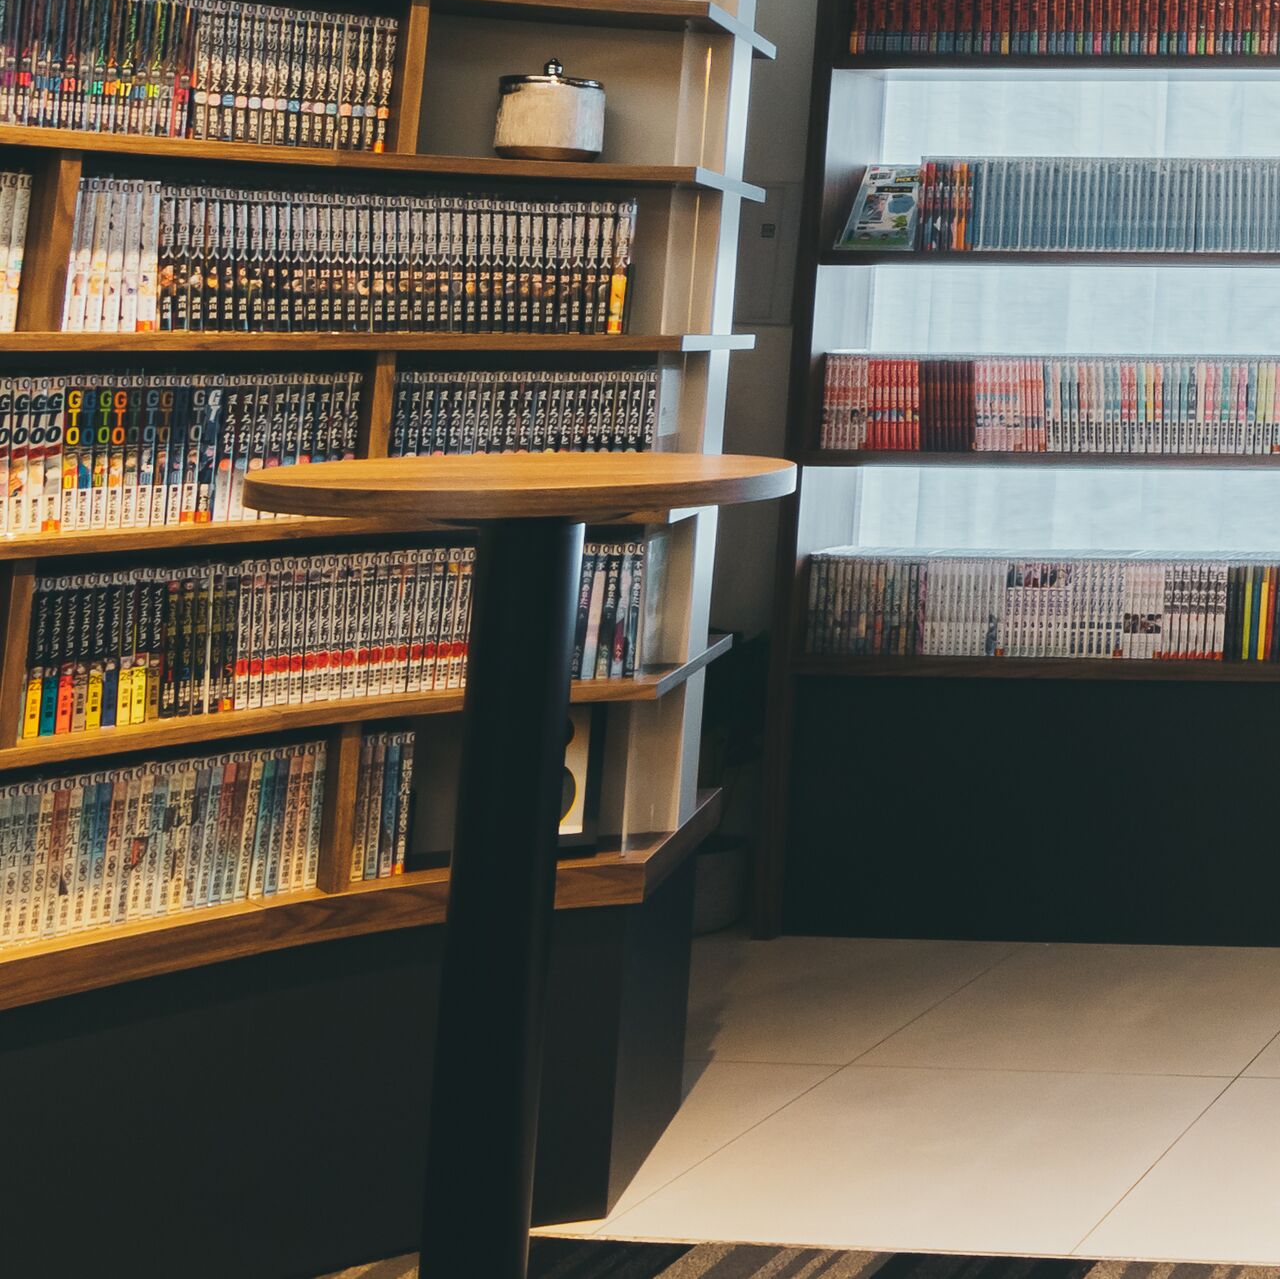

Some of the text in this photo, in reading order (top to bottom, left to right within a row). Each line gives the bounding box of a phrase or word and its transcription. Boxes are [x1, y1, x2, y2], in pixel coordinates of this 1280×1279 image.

[63, 78, 76, 92] 13
[93, 81, 103, 94] 15
[104, 81, 117, 95] 16
[120, 82, 132, 96] 17
[180, 264, 186, 273] 2
[210, 266, 216, 274] 4
[226, 267, 232, 275] 5
[240, 268, 246, 276] 6
[254, 268, 260, 276] 7
[268, 268, 274, 276] 8
[308, 269, 316, 277] 11
[320, 270, 330, 278] 12
[333, 270, 343, 278] 13
[360, 270, 369, 278] 15
[387, 271, 395, 279] 17
[439, 271, 449, 279] 21
[413, 272, 423, 280] 19
[426, 272, 436, 280] 20
[13, 393, 30, 445] GTO
[29, 393, 48, 445] GTO
[45, 393, 64, 443] GTO
[66, 390, 82, 445] GTO
[97, 390, 112, 443] GTO
[112, 390, 127, 445] GTO
[144, 390, 159, 442] GTO
[159, 390, 174, 443] GTO
[190, 390, 205, 441] GTO
[95, 592, 106, 654] インフェクション
[110, 590, 121, 652] インフェクション
[124, 590, 135, 651] インフェクション
[139, 587, 149, 647] インフェクション
[153, 588, 163, 648] インフェクション
[35, 597, 48, 660] インフェクション
[50, 596, 64, 658] インフェクション
[66, 595, 78, 657] インフェクション
[80, 594, 92, 656] インフェクション
[89, 675, 100, 684] 26
[121, 670, 131, 681] 28
[135, 668, 146, 677] 29
[29, 680, 41, 691] 22
